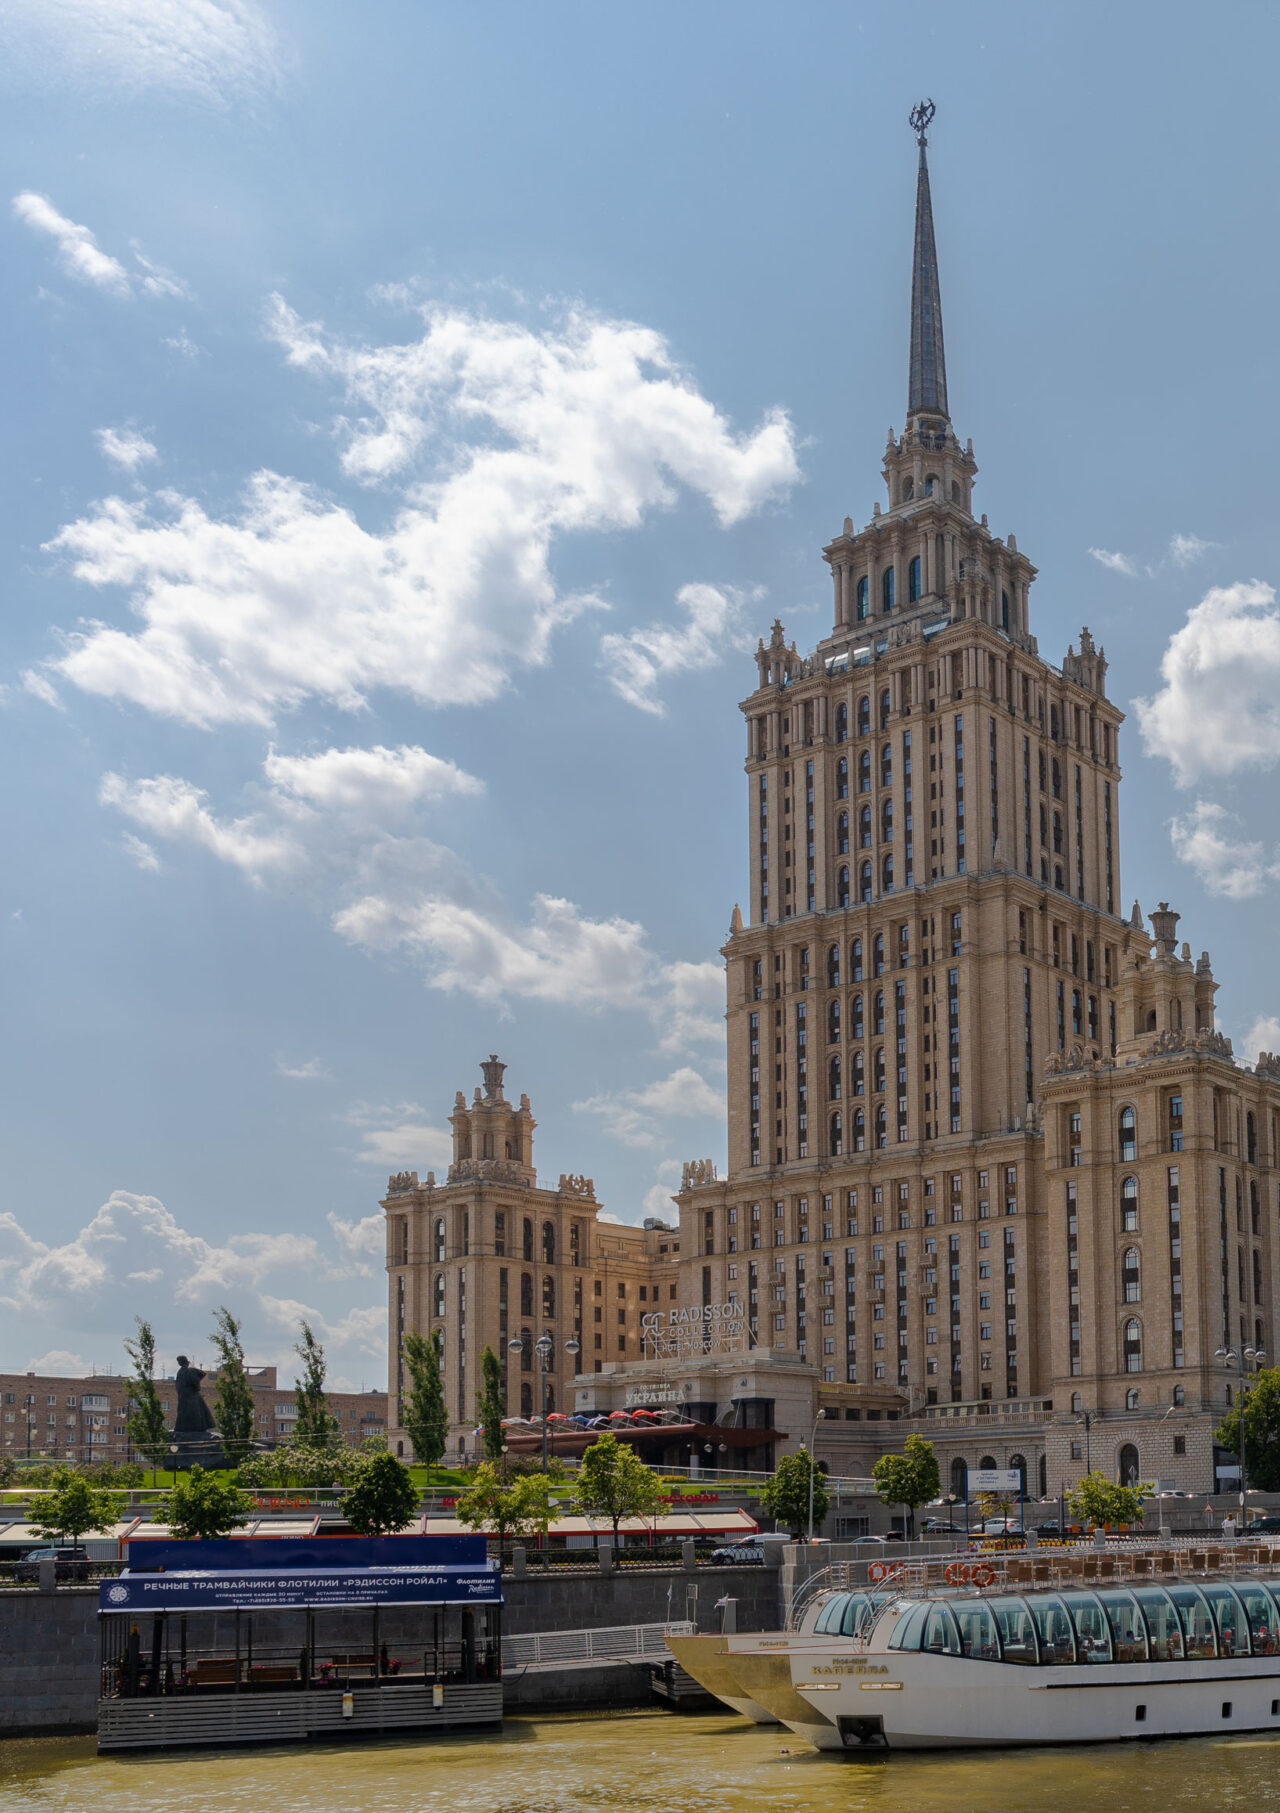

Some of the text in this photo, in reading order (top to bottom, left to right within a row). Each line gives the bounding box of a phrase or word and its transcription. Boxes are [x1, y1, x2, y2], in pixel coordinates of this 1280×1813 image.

[669, 1302, 745, 1324] RADISSON
[669, 1321, 745, 1337] COLLECTION
[662, 1340, 721, 1352] HOTEL MOSCOW
[626, 1390, 685, 1405] УКРАИНА
[144, 1576, 448, 1591] РЕЧНЫЕ ТРАМВАЙЧИКИ ФЛОТИЛИИ «РЭДИССОН РОЙАЛ»
[812, 1666, 888, 1675] КАПЕЛЛА
